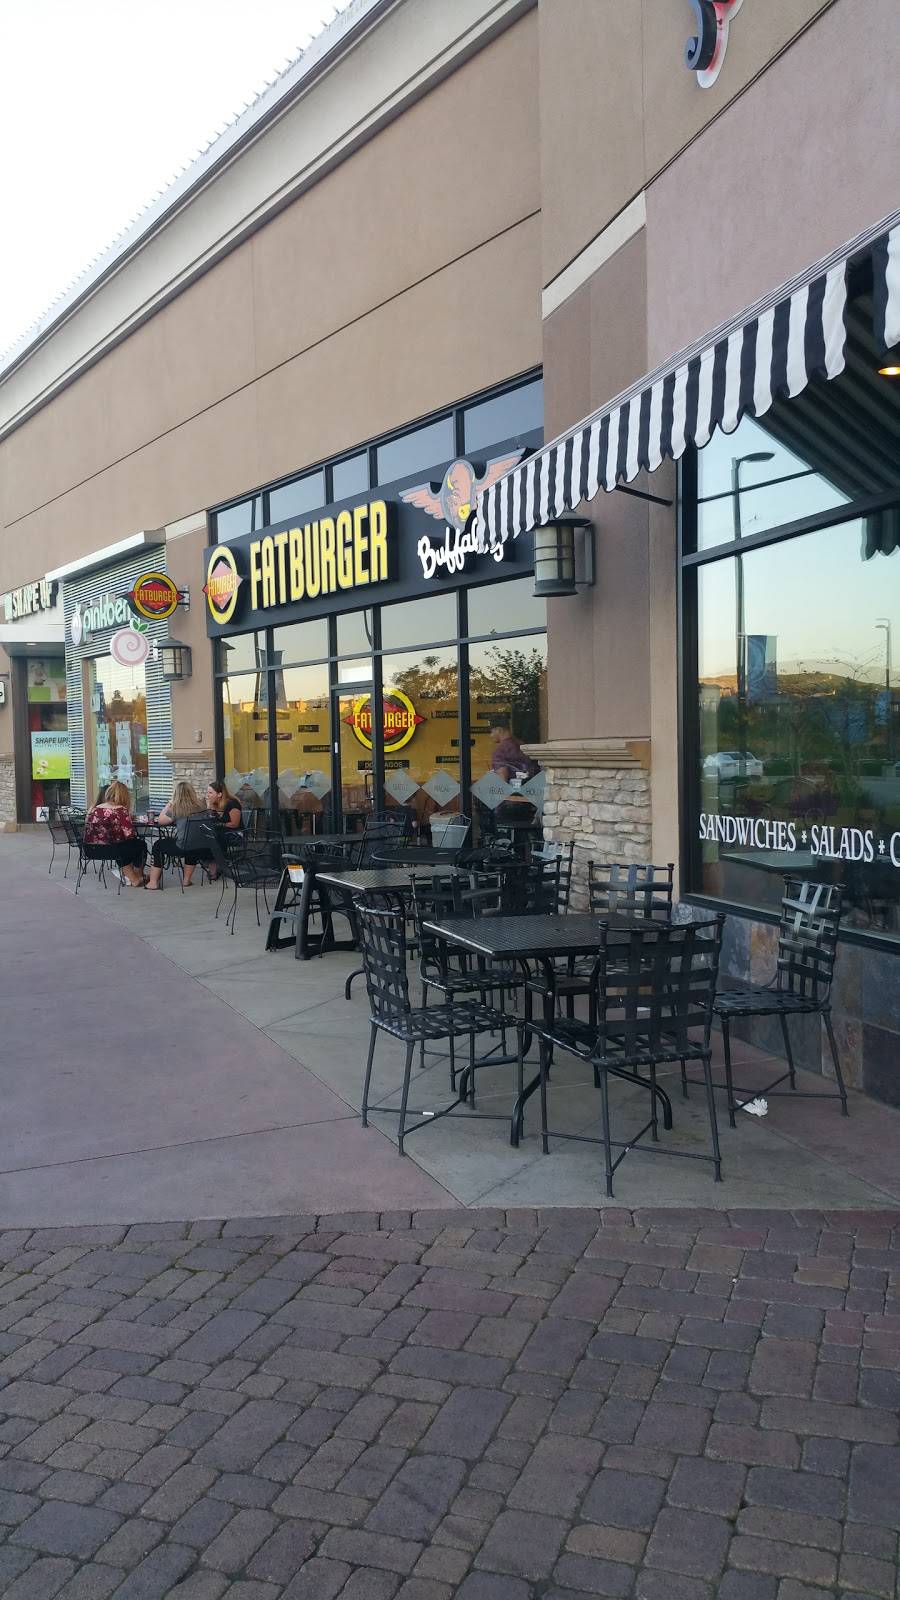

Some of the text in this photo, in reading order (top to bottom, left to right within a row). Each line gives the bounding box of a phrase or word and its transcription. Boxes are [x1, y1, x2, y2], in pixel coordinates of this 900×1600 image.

[250, 500, 388, 611] FATBURGER
[83, 594, 131, 641] pinkber
[134, 589, 177, 601] FATBURGER
[353, 712, 415, 728] FATURGER
[699, 813, 797, 852] SANDWICHES
[810, 824, 874, 863] SALADS
